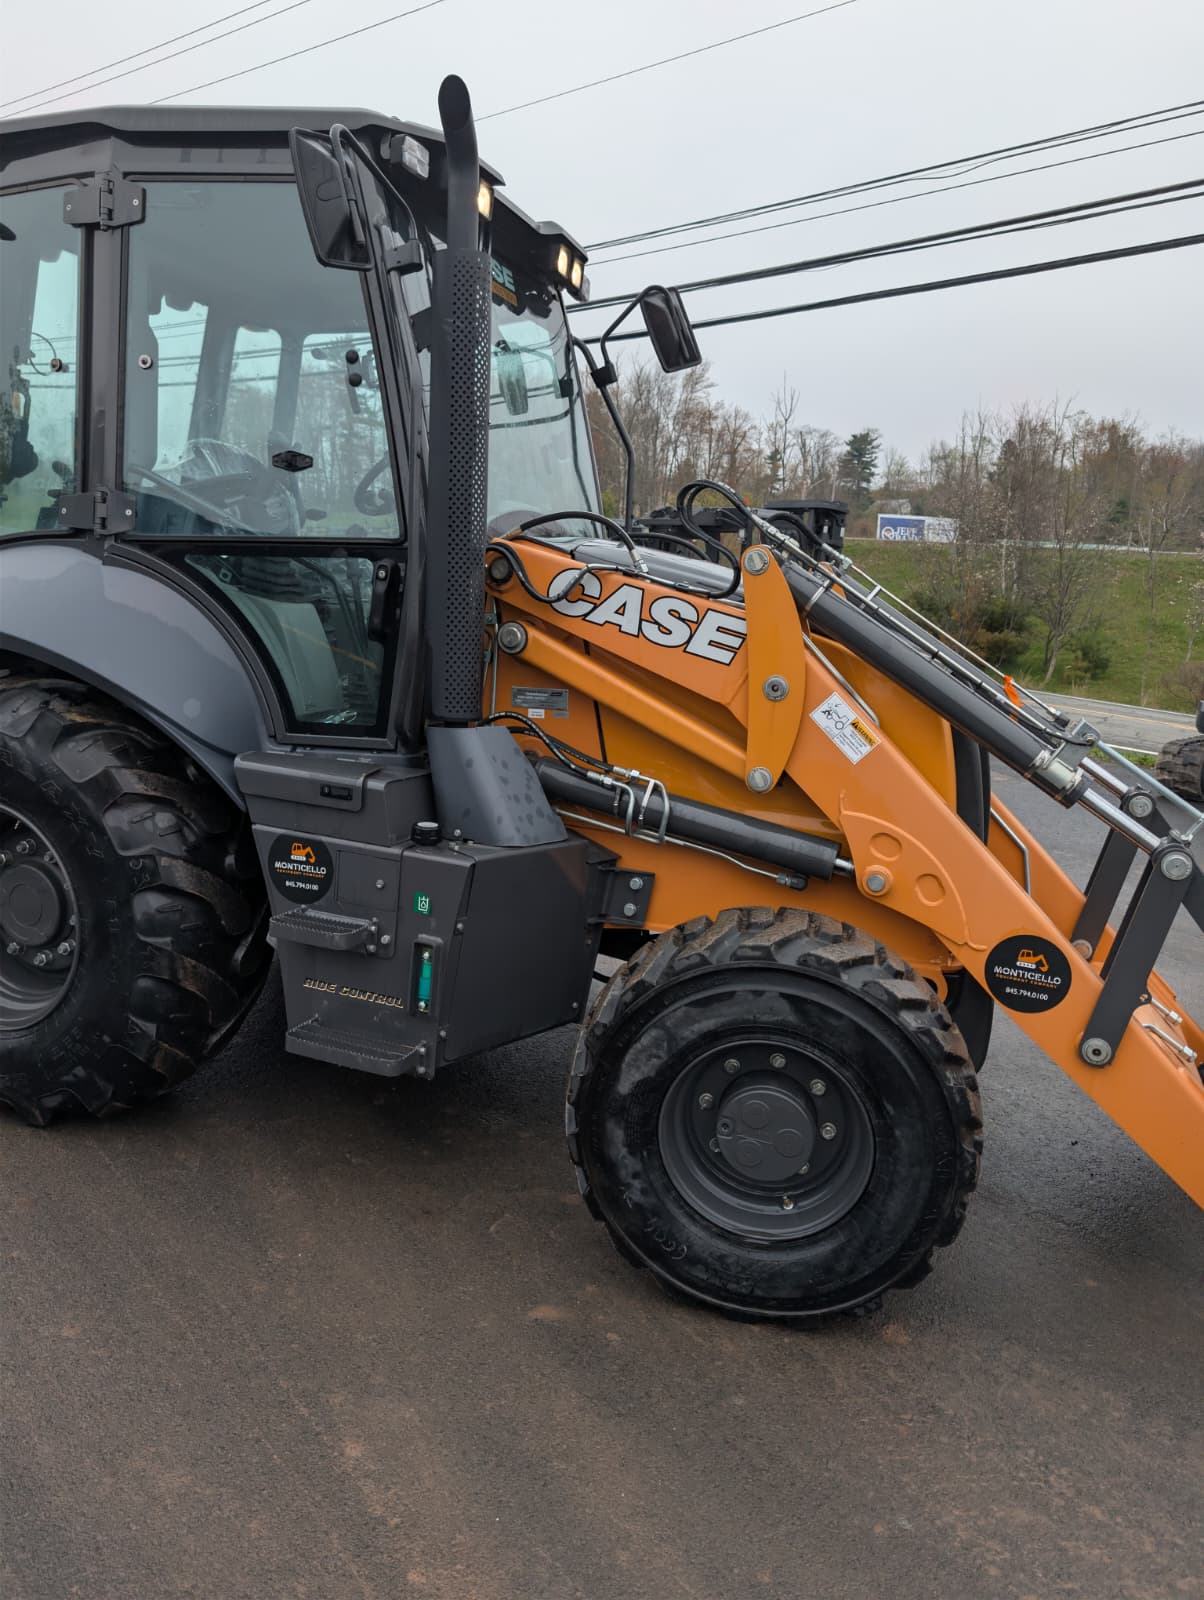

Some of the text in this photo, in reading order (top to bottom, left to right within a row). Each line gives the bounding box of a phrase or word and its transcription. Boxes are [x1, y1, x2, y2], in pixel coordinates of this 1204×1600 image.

[491, 257, 516, 292] SE
[547, 567, 748, 666] CASE
[274, 860, 327, 875] MONTICELLO
[993, 965, 1062, 985] MONTICELLO
[303, 977, 404, 1009] RIDE CONTROL
[1005, 986, 1049, 1001] 845.794.0100
